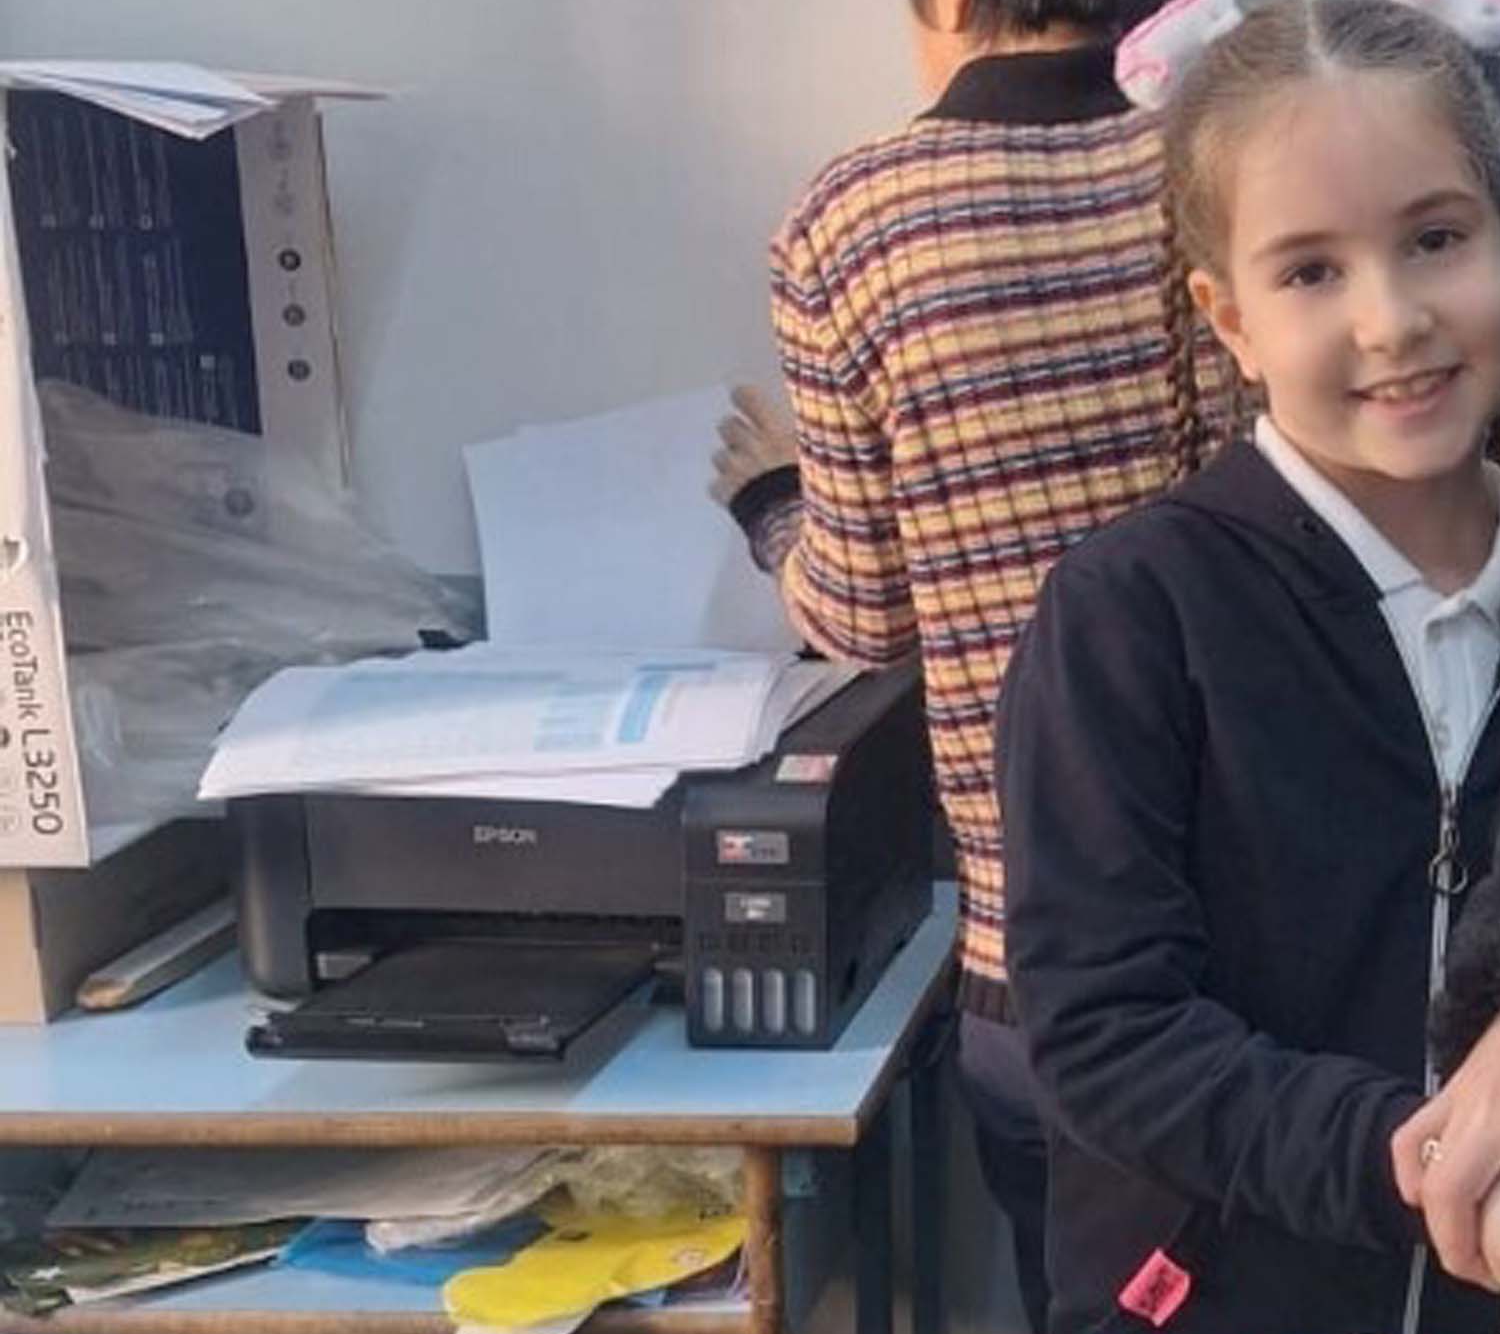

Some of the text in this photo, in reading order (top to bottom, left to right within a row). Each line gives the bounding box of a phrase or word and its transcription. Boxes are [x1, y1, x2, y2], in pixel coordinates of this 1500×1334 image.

[6, 610, 64, 836] EcoTank L3250
[472, 825, 538, 845] EPSON
